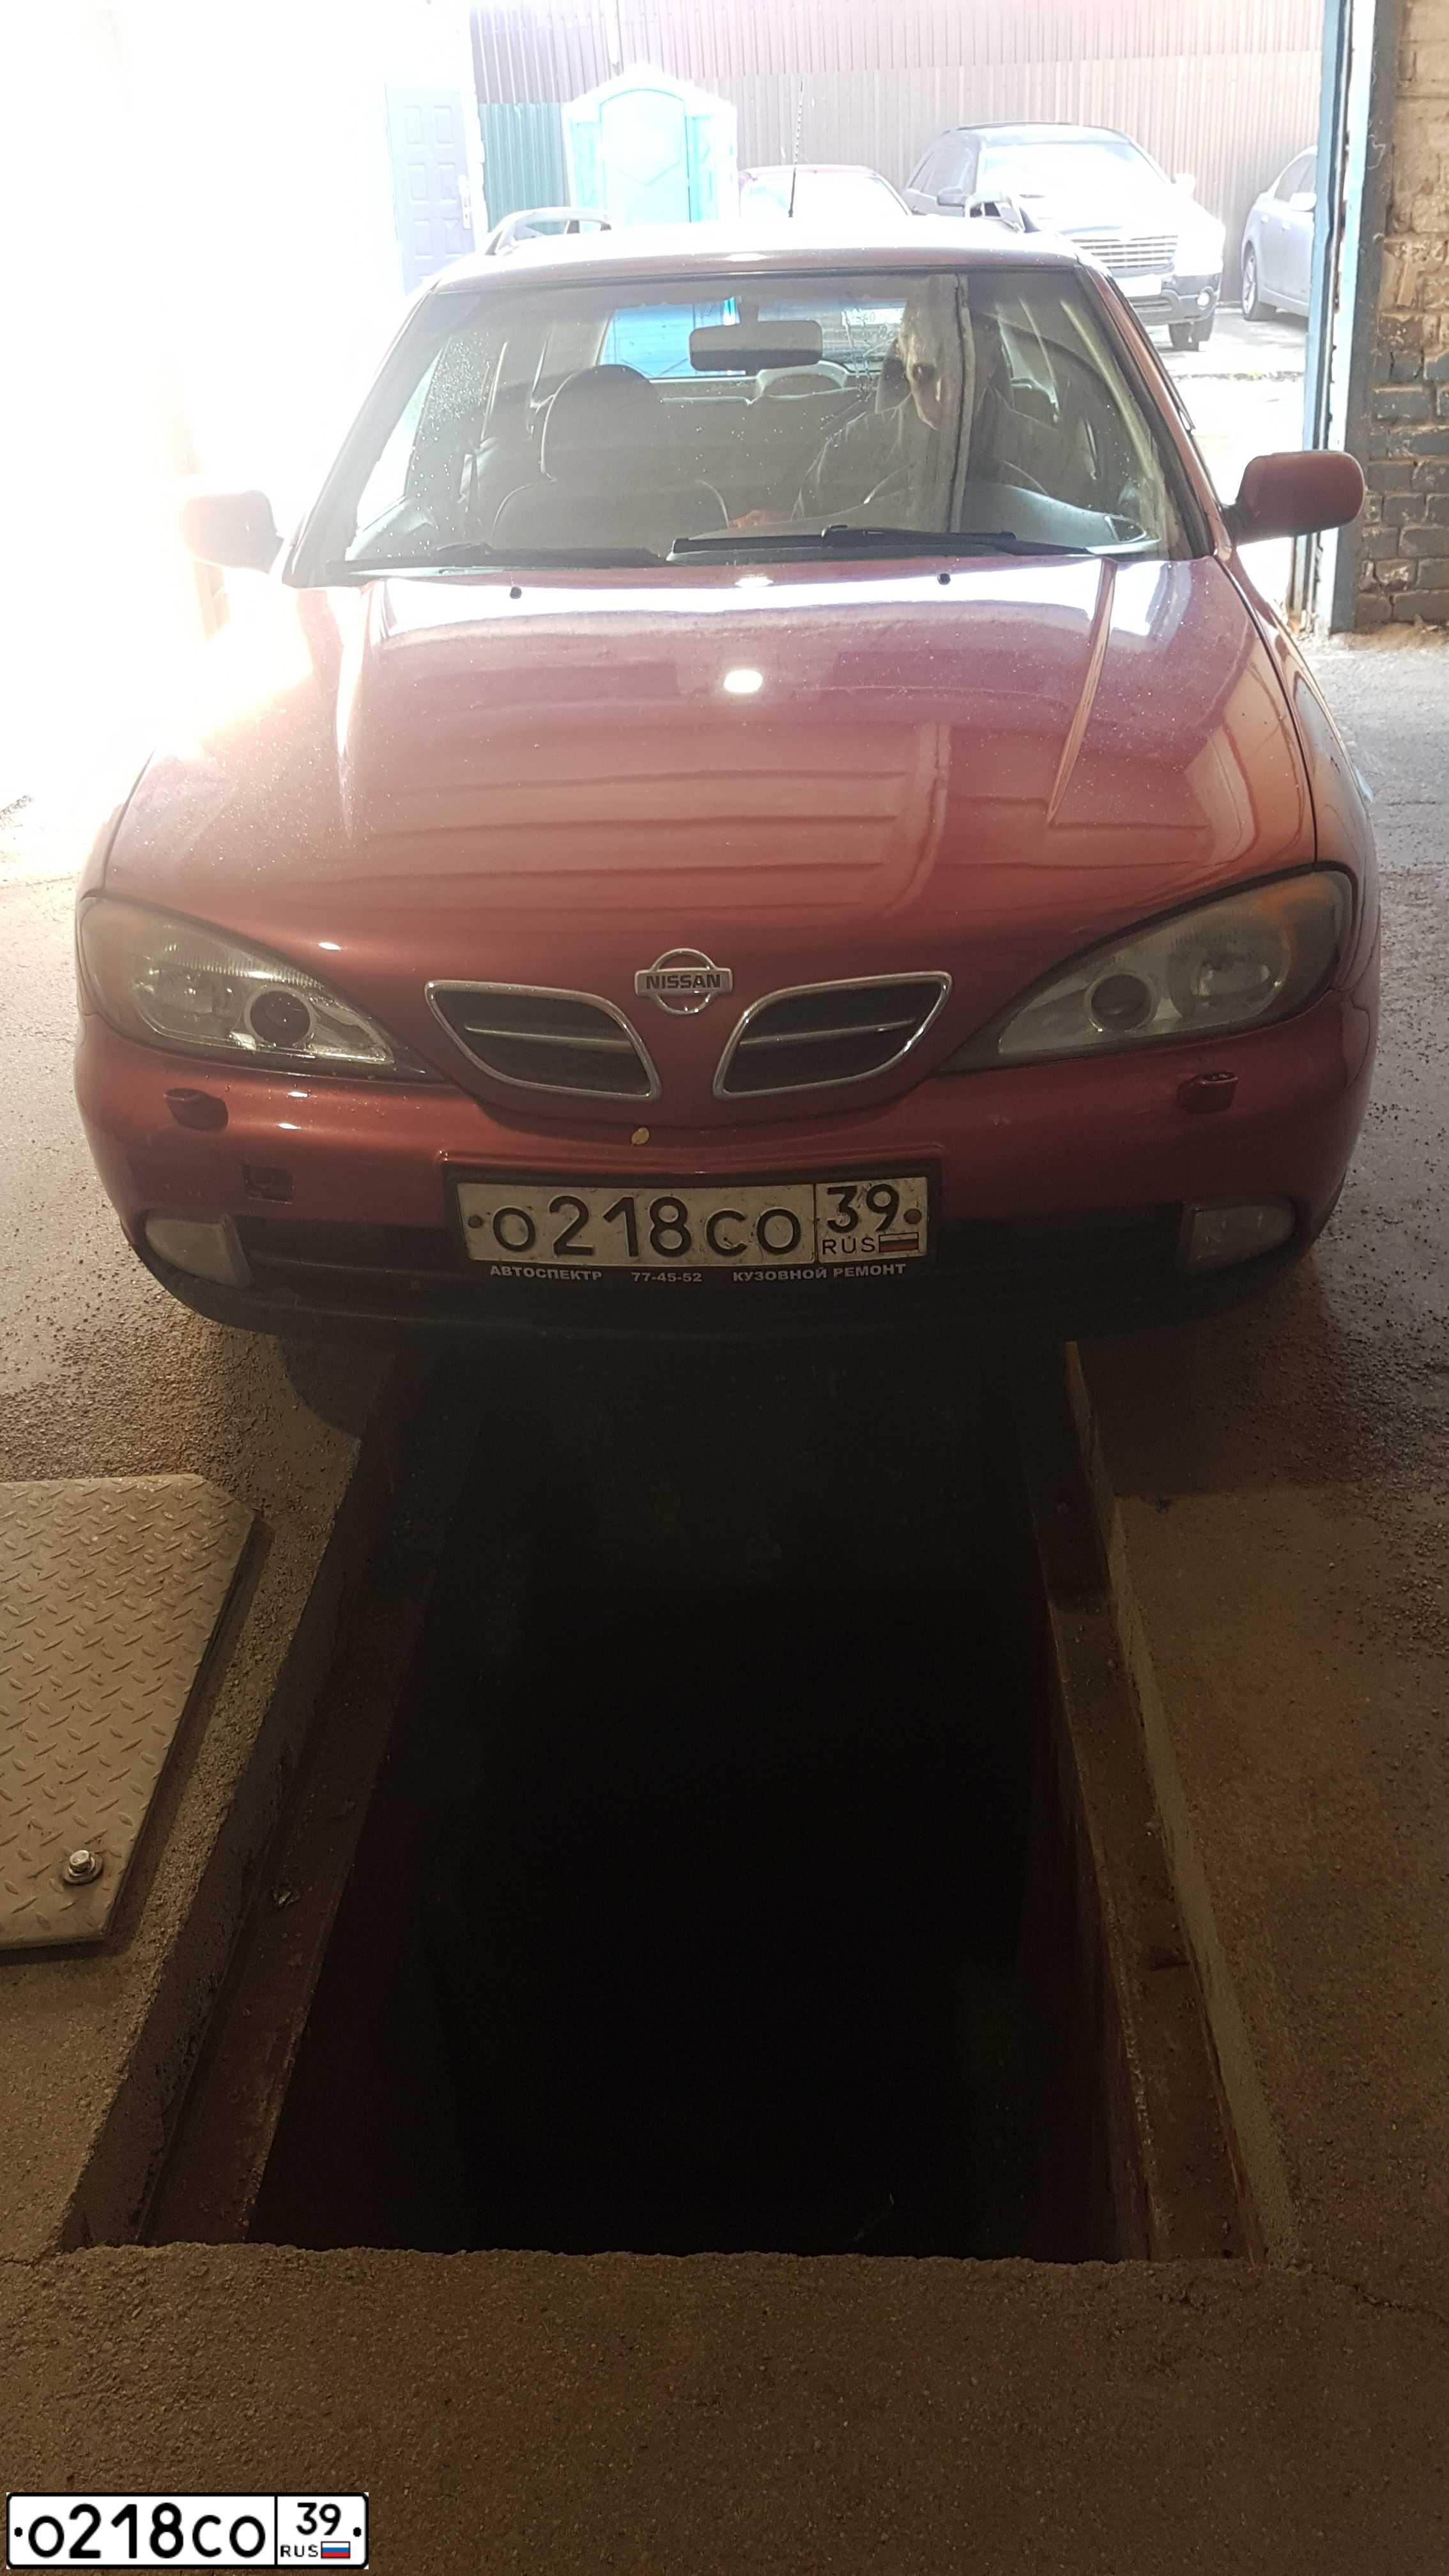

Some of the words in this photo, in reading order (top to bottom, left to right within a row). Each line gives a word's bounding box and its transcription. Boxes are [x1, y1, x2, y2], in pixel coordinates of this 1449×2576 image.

[646, 974, 721, 989] NISSAN
[826, 1183, 900, 1233] 39
[822, 1236, 875, 1255] RUS
[490, 1265, 602, 1281] АВТОСПЕКТР
[631, 1272, 702, 1282] 77-45-52
[733, 1267, 827, 1282] КУЗОВНОЙ
[833, 1263, 907, 1278] РЕМОНТ
